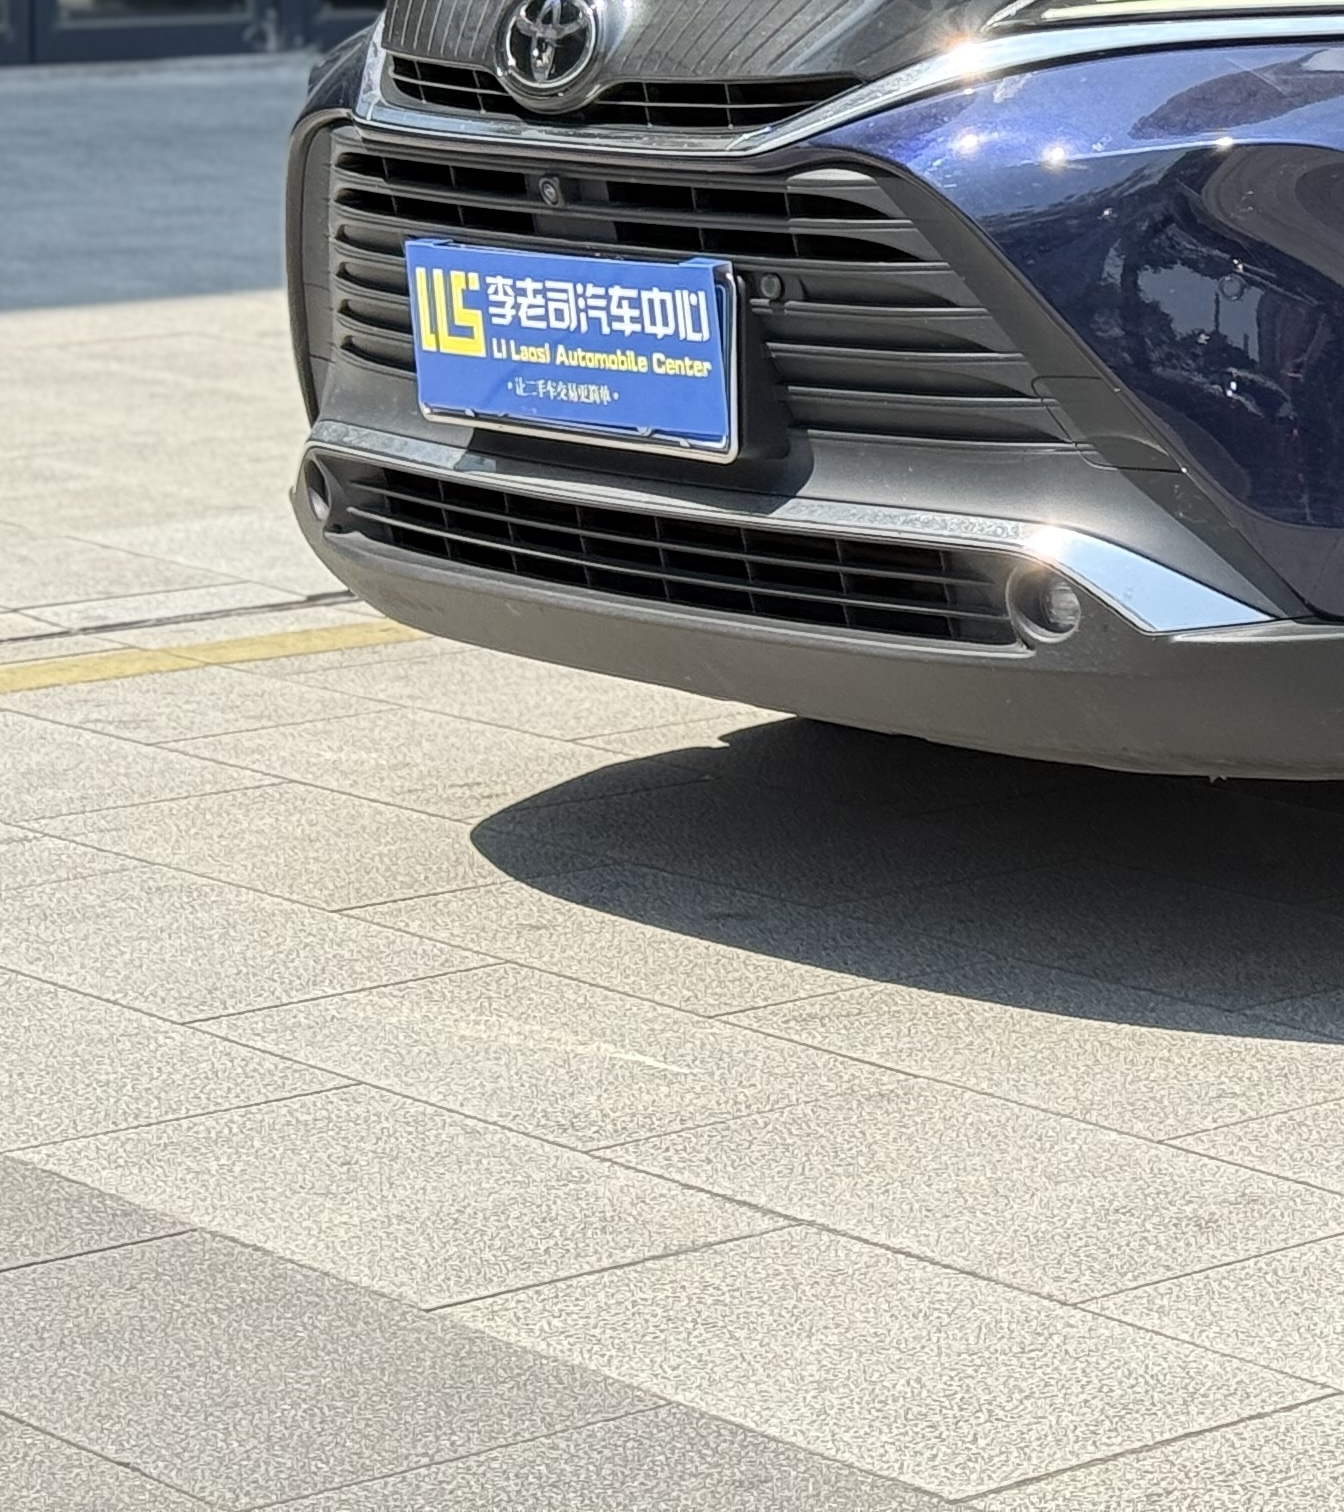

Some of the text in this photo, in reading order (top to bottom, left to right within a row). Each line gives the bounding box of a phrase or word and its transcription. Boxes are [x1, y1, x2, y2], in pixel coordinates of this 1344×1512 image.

[485, 275, 711, 343] 李老司汽车中心
[555, 343, 648, 373] Automobile
[651, 352, 713, 378] Center
